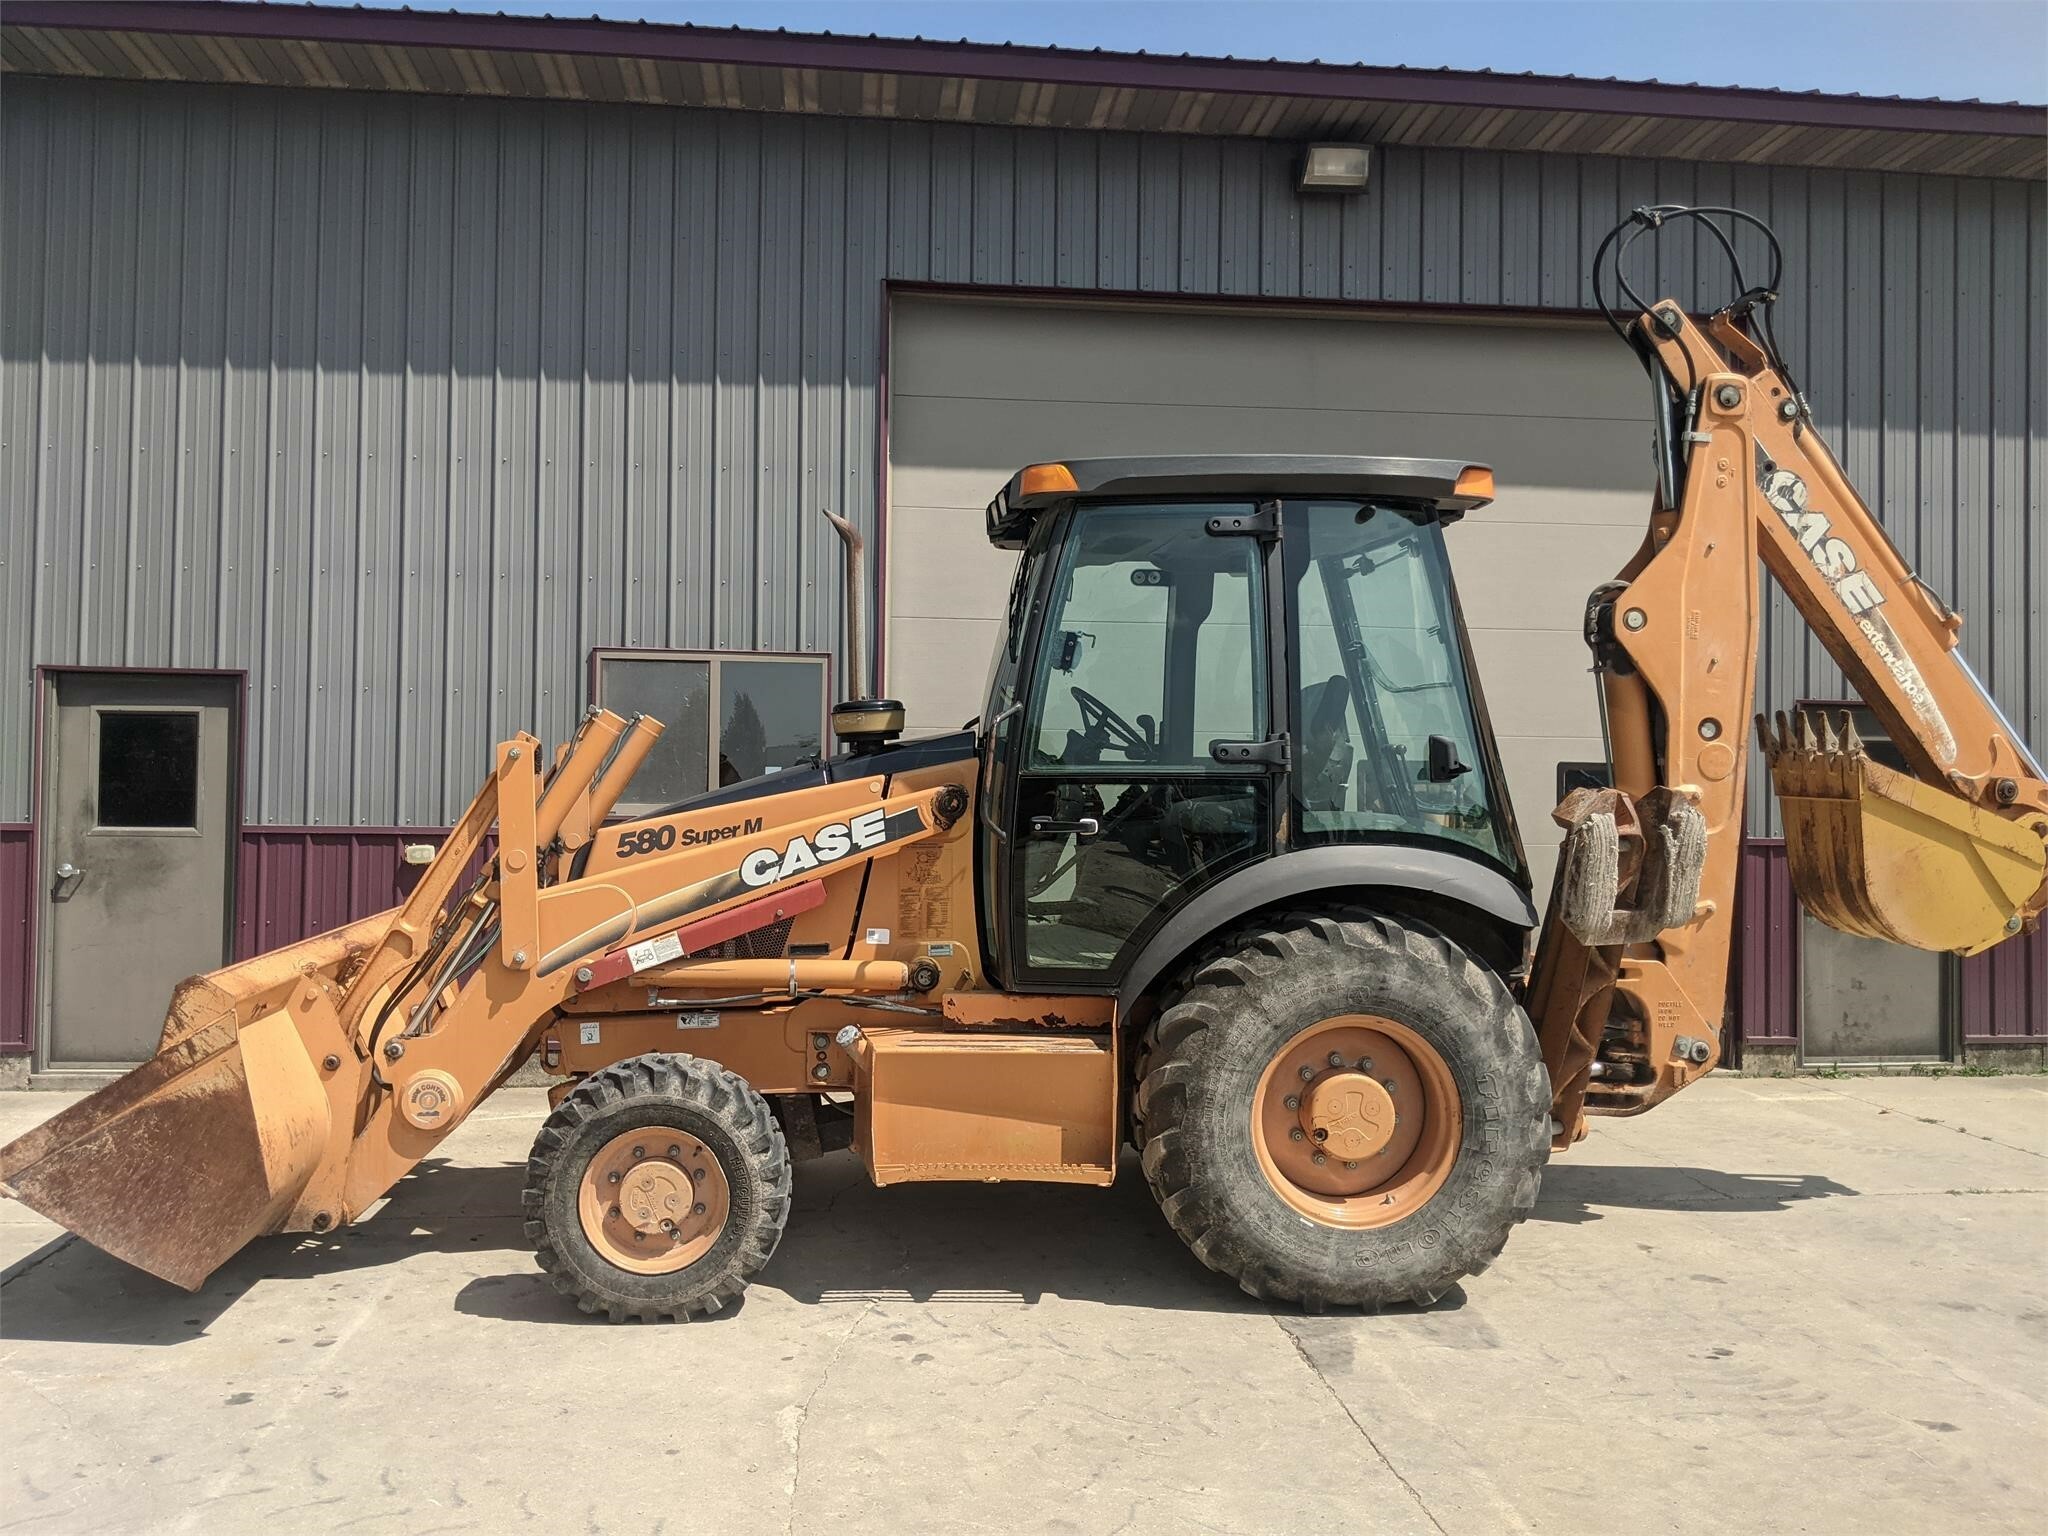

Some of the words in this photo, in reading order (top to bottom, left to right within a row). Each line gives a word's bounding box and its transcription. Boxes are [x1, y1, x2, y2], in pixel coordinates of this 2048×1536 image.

[1765, 469, 1886, 615] CASE
[616, 824, 676, 858] 580
[681, 823, 740, 846] Super
[744, 817, 763, 836] M
[740, 807, 886, 886] CASE
